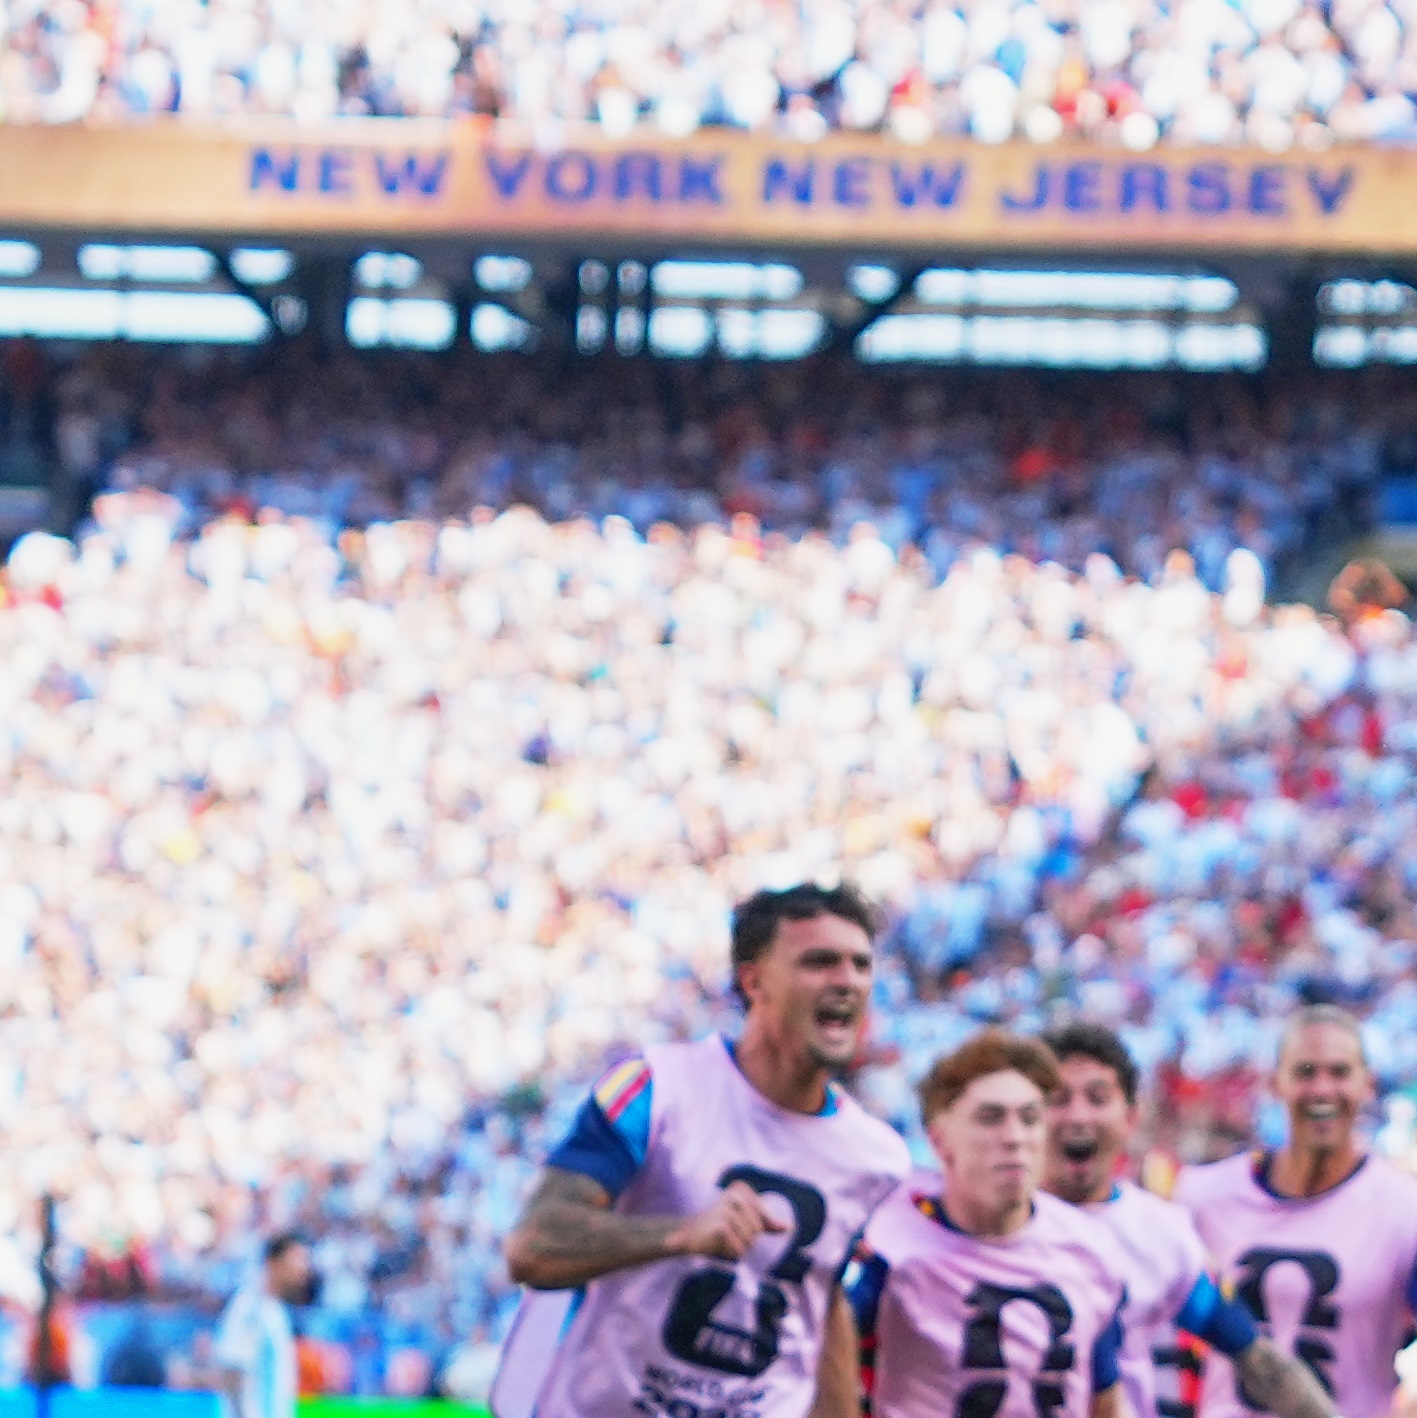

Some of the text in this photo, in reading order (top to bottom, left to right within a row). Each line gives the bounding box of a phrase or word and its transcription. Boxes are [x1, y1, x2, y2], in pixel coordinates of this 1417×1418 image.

[250, 147, 1354, 216] NEW YORK NEW JERSEY
